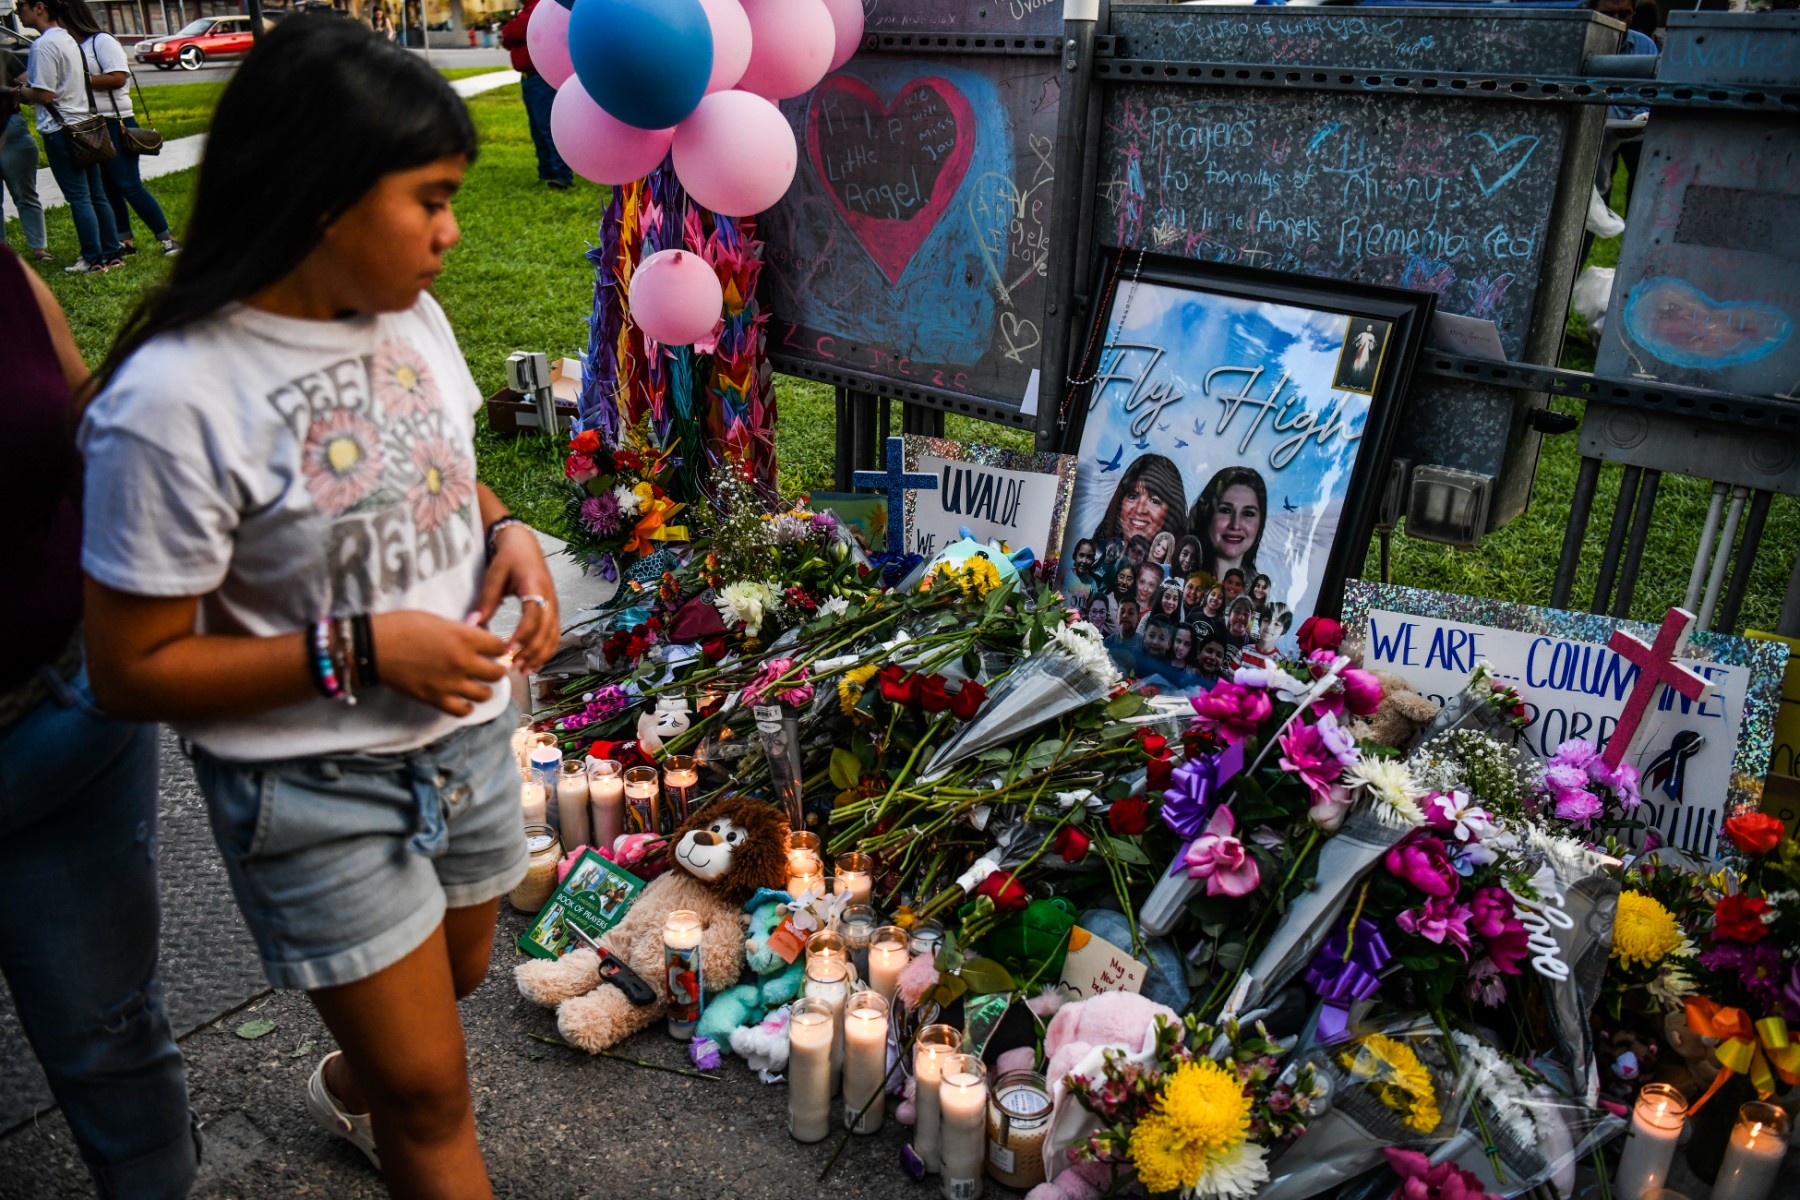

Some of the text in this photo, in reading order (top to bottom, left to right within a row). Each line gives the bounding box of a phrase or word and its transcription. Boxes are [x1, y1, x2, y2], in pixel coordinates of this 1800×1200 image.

[1150, 106, 1256, 165] Prayers
[1256, 209, 1322, 249] Angels
[1337, 215, 1538, 262] Remembred
[1088, 341, 1362, 470] Fly High
[942, 465, 1025, 528] UVALDE
[917, 528, 936, 556] WE
[1370, 617, 1419, 666] WE
[556, 893, 608, 929] BOOK OF PRAYERS
